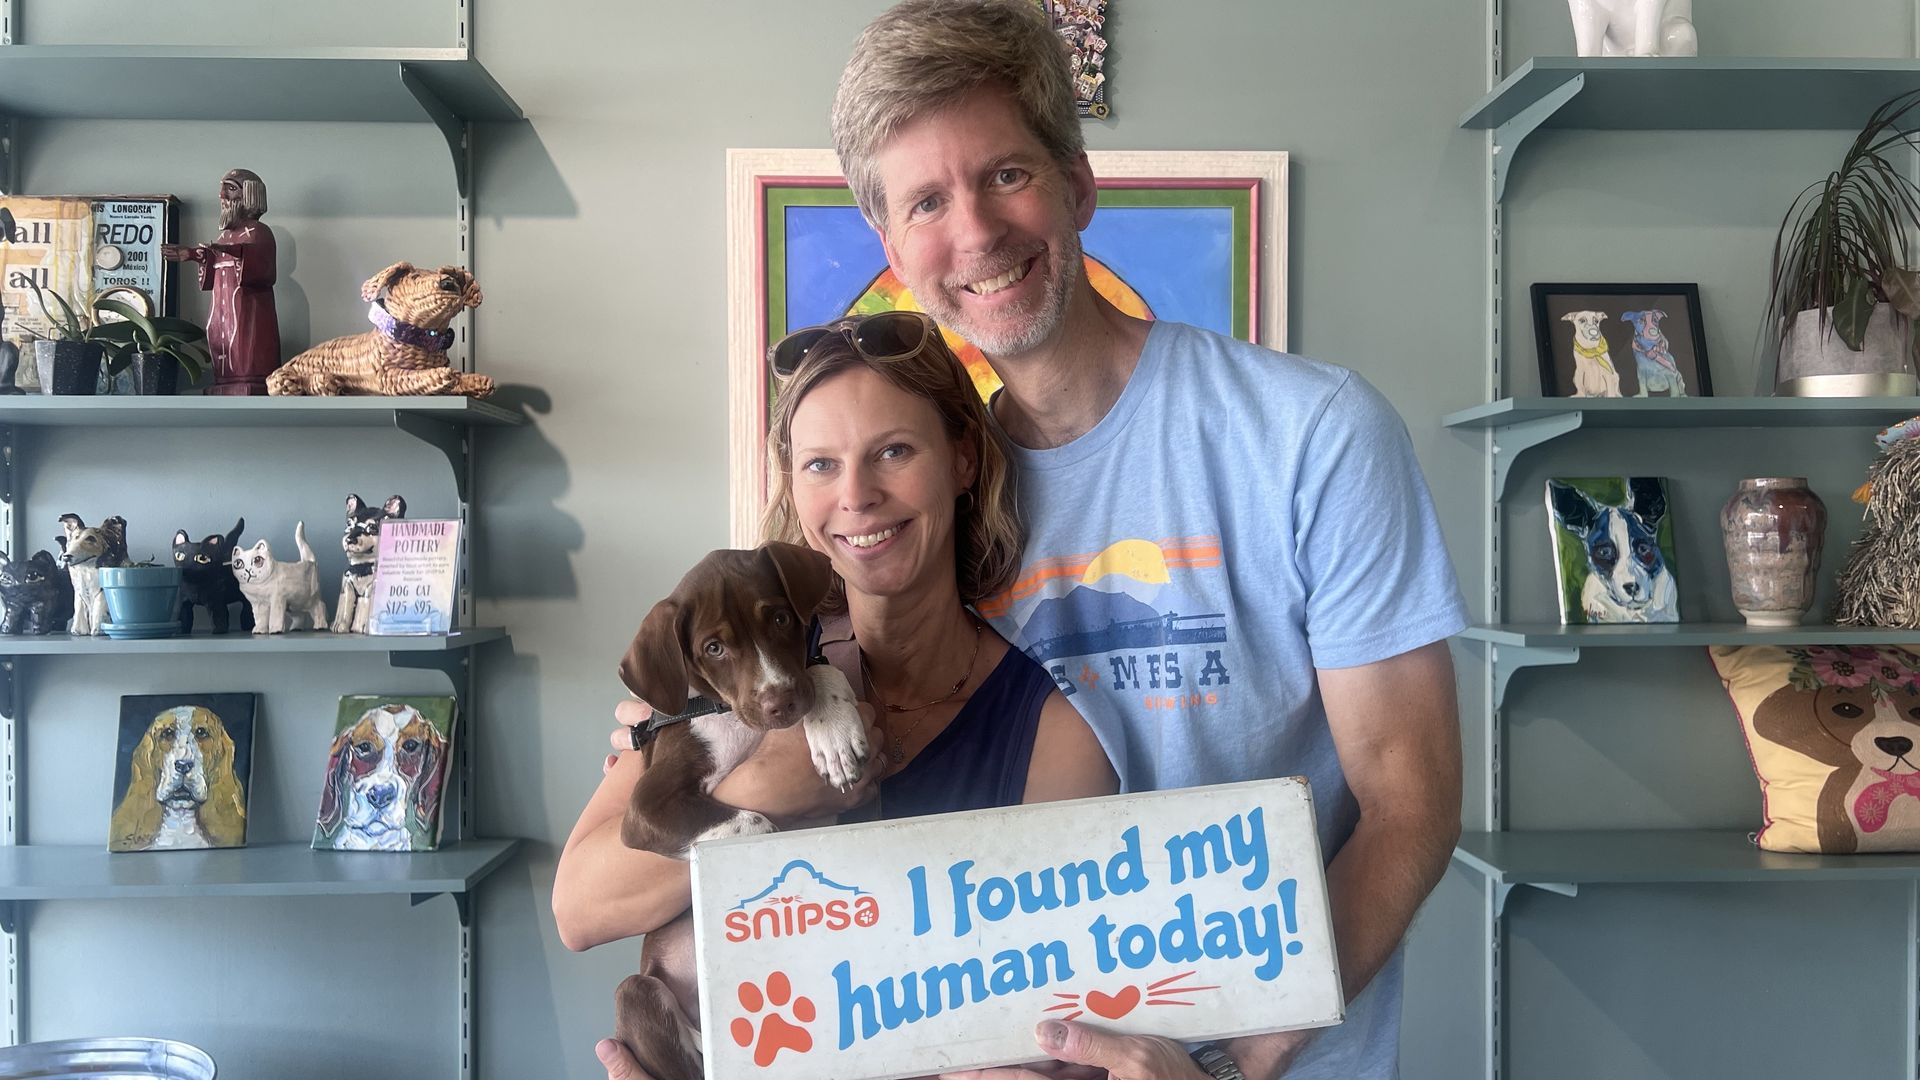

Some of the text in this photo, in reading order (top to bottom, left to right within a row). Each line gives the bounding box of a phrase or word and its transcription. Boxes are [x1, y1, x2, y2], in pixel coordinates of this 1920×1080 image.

[128, 251, 148, 262] 2001
[9, 268, 48, 289] all
[392, 523, 446, 537] HANDMADE
[394, 539, 441, 553] POTTERY
[390, 584, 430, 597] DOG CAT
[414, 600, 431, 615] $95
[907, 806, 1271, 938] I found my
[831, 878, 1304, 1051] human today!
